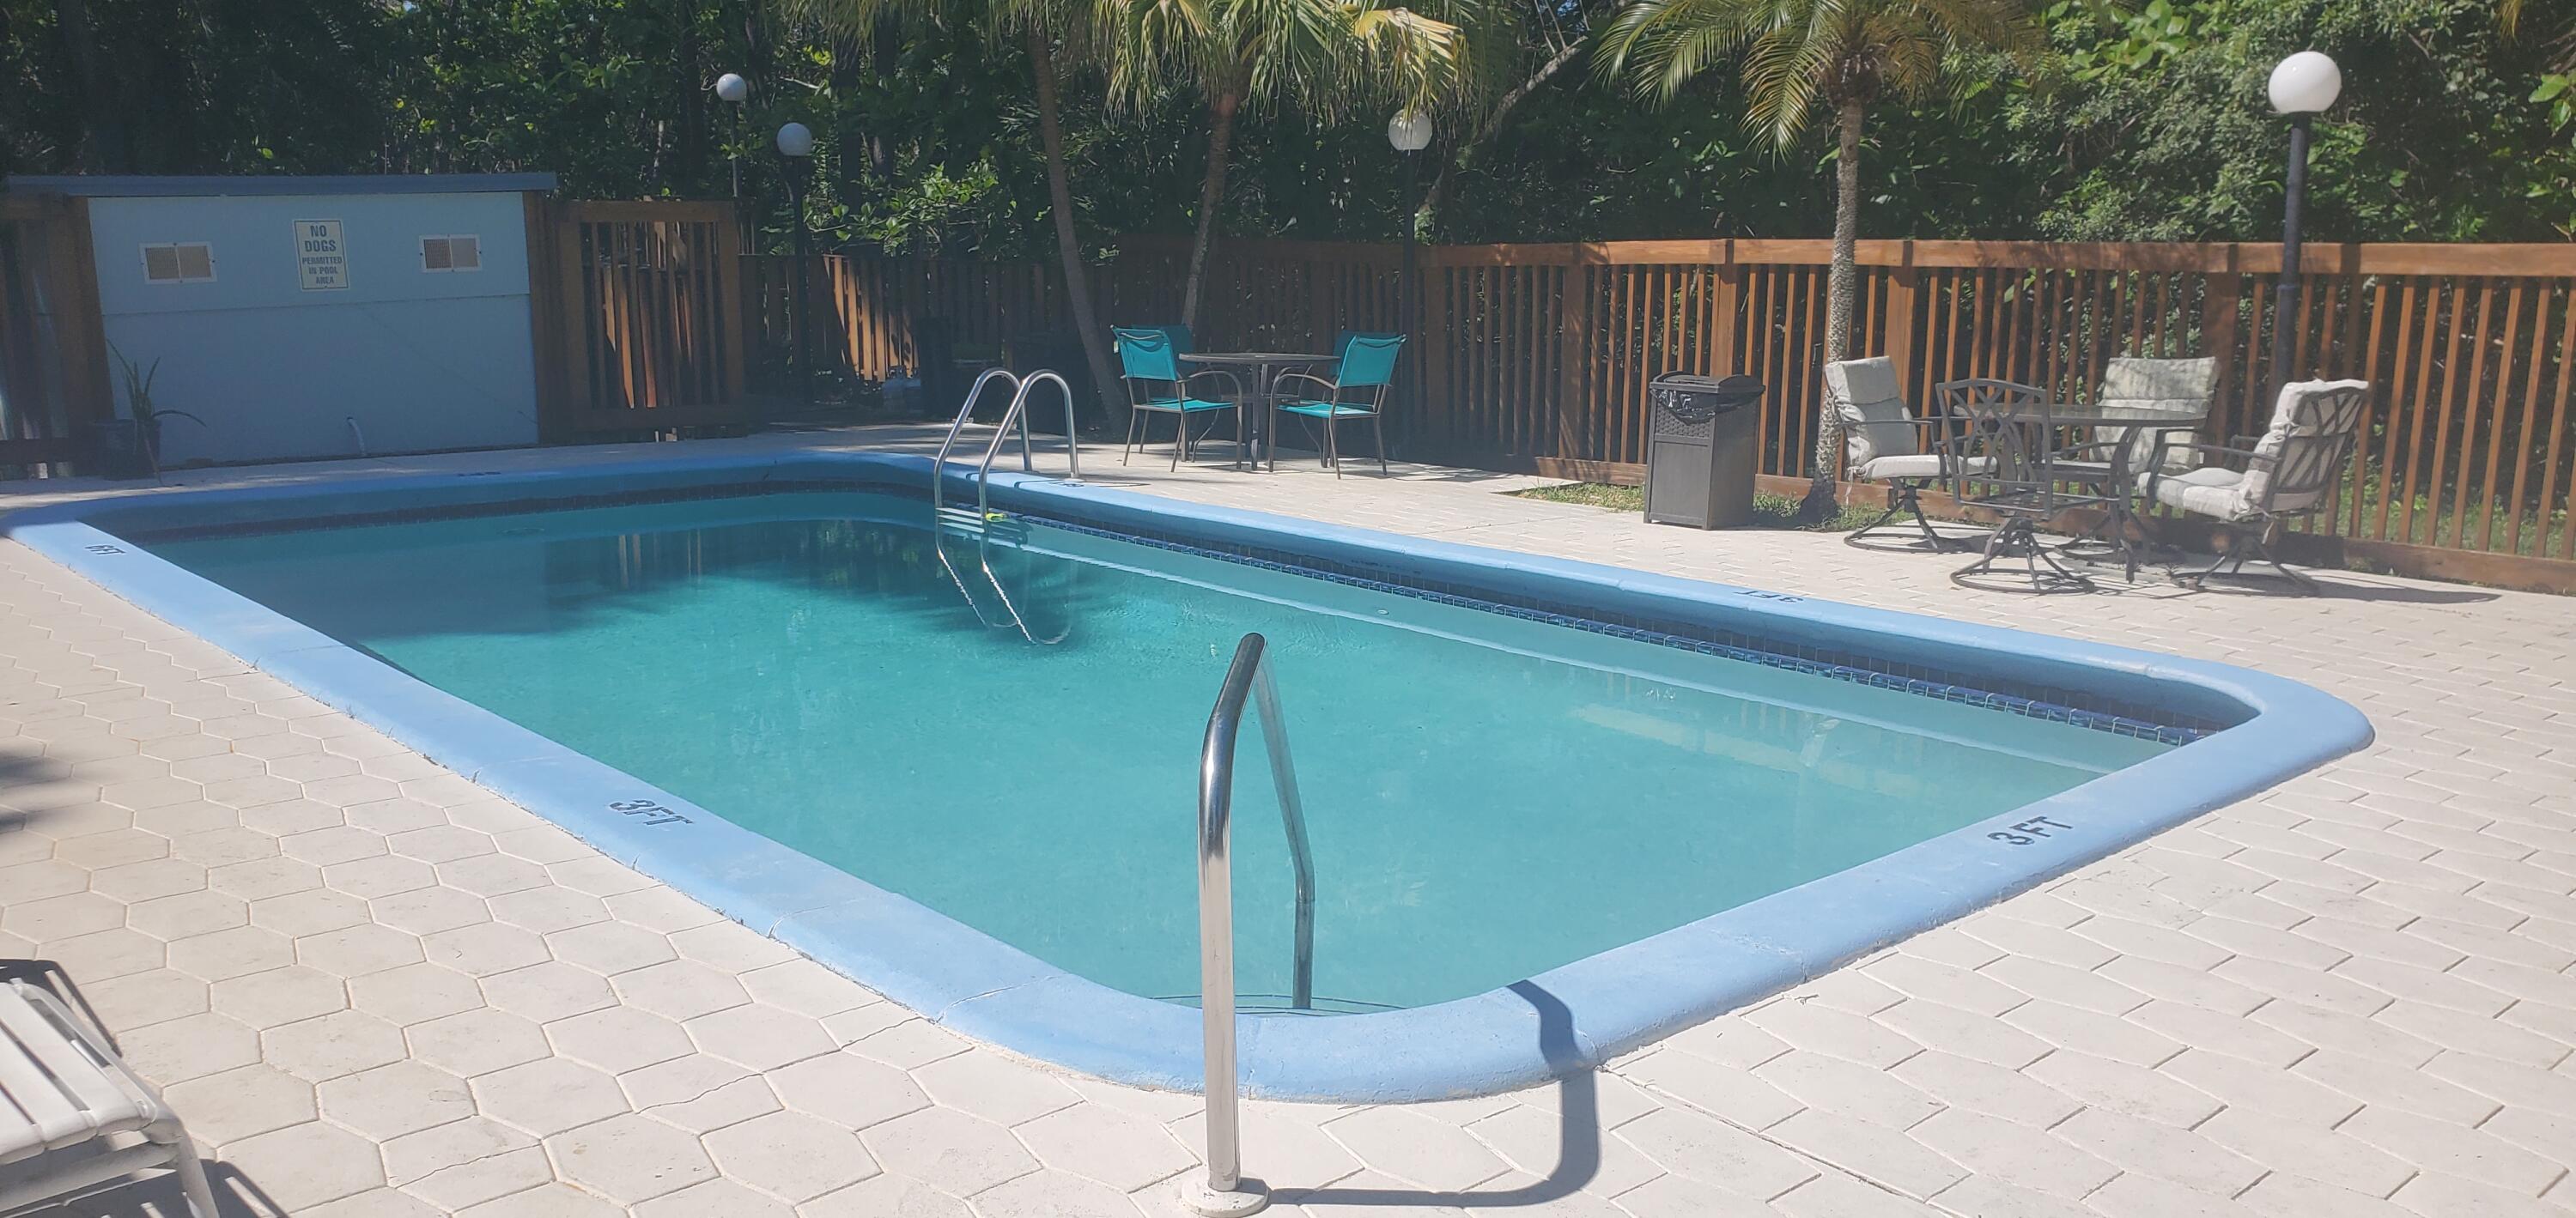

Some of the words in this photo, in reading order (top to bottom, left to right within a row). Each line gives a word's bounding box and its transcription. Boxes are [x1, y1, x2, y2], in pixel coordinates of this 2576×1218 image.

[310, 225, 327, 238] NO
[304, 239, 337, 252] DOGS
[301, 256, 343, 264] PERMITTED
[309, 266, 318, 275] IN
[319, 266, 338, 275] POOL
[84, 544, 126, 555] 6FT
[609, 799, 694, 825] 3FT
[1986, 815, 2074, 845] 3FT
